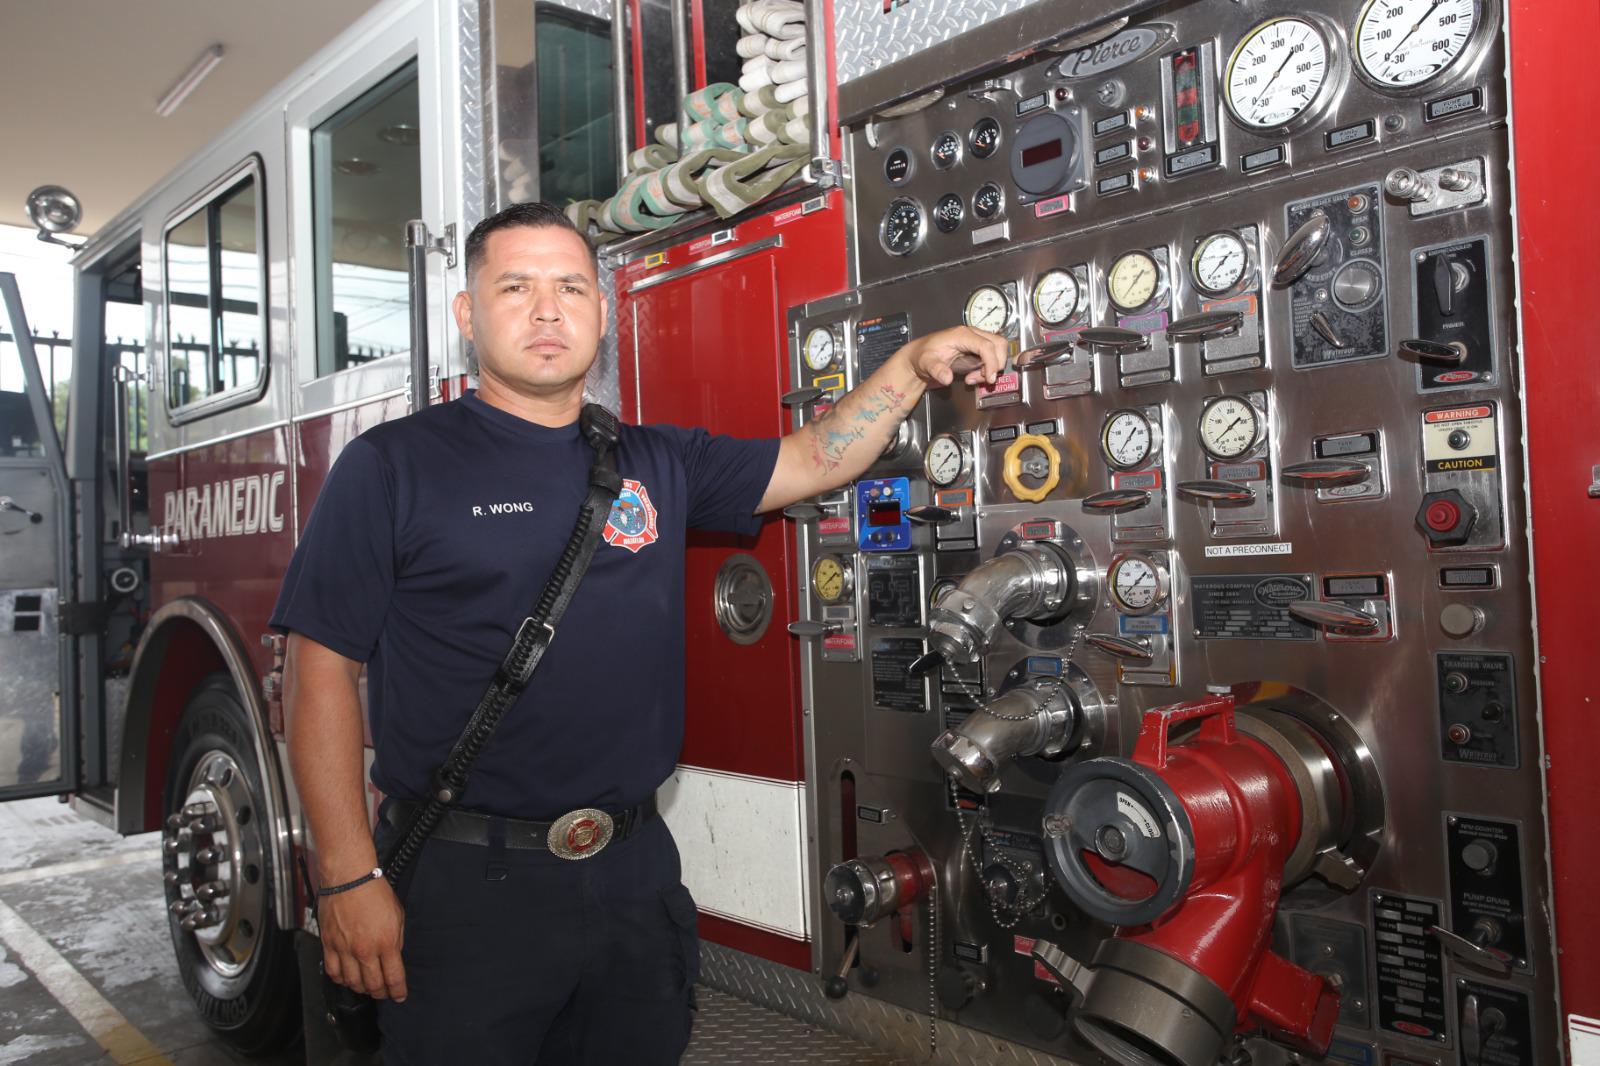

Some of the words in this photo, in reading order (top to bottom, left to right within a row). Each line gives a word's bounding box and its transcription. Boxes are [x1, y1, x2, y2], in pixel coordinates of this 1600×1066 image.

[1386, 6, 1403, 19] 200
[1439, 13, 1457, 27] 500
[1376, 28, 1392, 40] 100
[1270, 38, 1285, 50] 300
[1432, 38, 1450, 52] 600
[1072, 35, 1140, 75] Pierce
[1251, 54, 1266, 66] 200
[1296, 61, 1311, 74] 500
[1244, 75, 1258, 86] 100
[1291, 84, 1306, 97] 600
[1436, 409, 1479, 420] WARNING
[1437, 458, 1483, 470] CAUTION
[164, 470, 285, 541] PARAMEDIC
[472, 506, 487, 517] R.
[489, 502, 534, 515] WONG
[1206, 546, 1223, 555] NOT
[1224, 545, 1232, 555] A
[1232, 543, 1291, 555] PRECONNECT
[1119, 797, 1131, 807] OPEN
